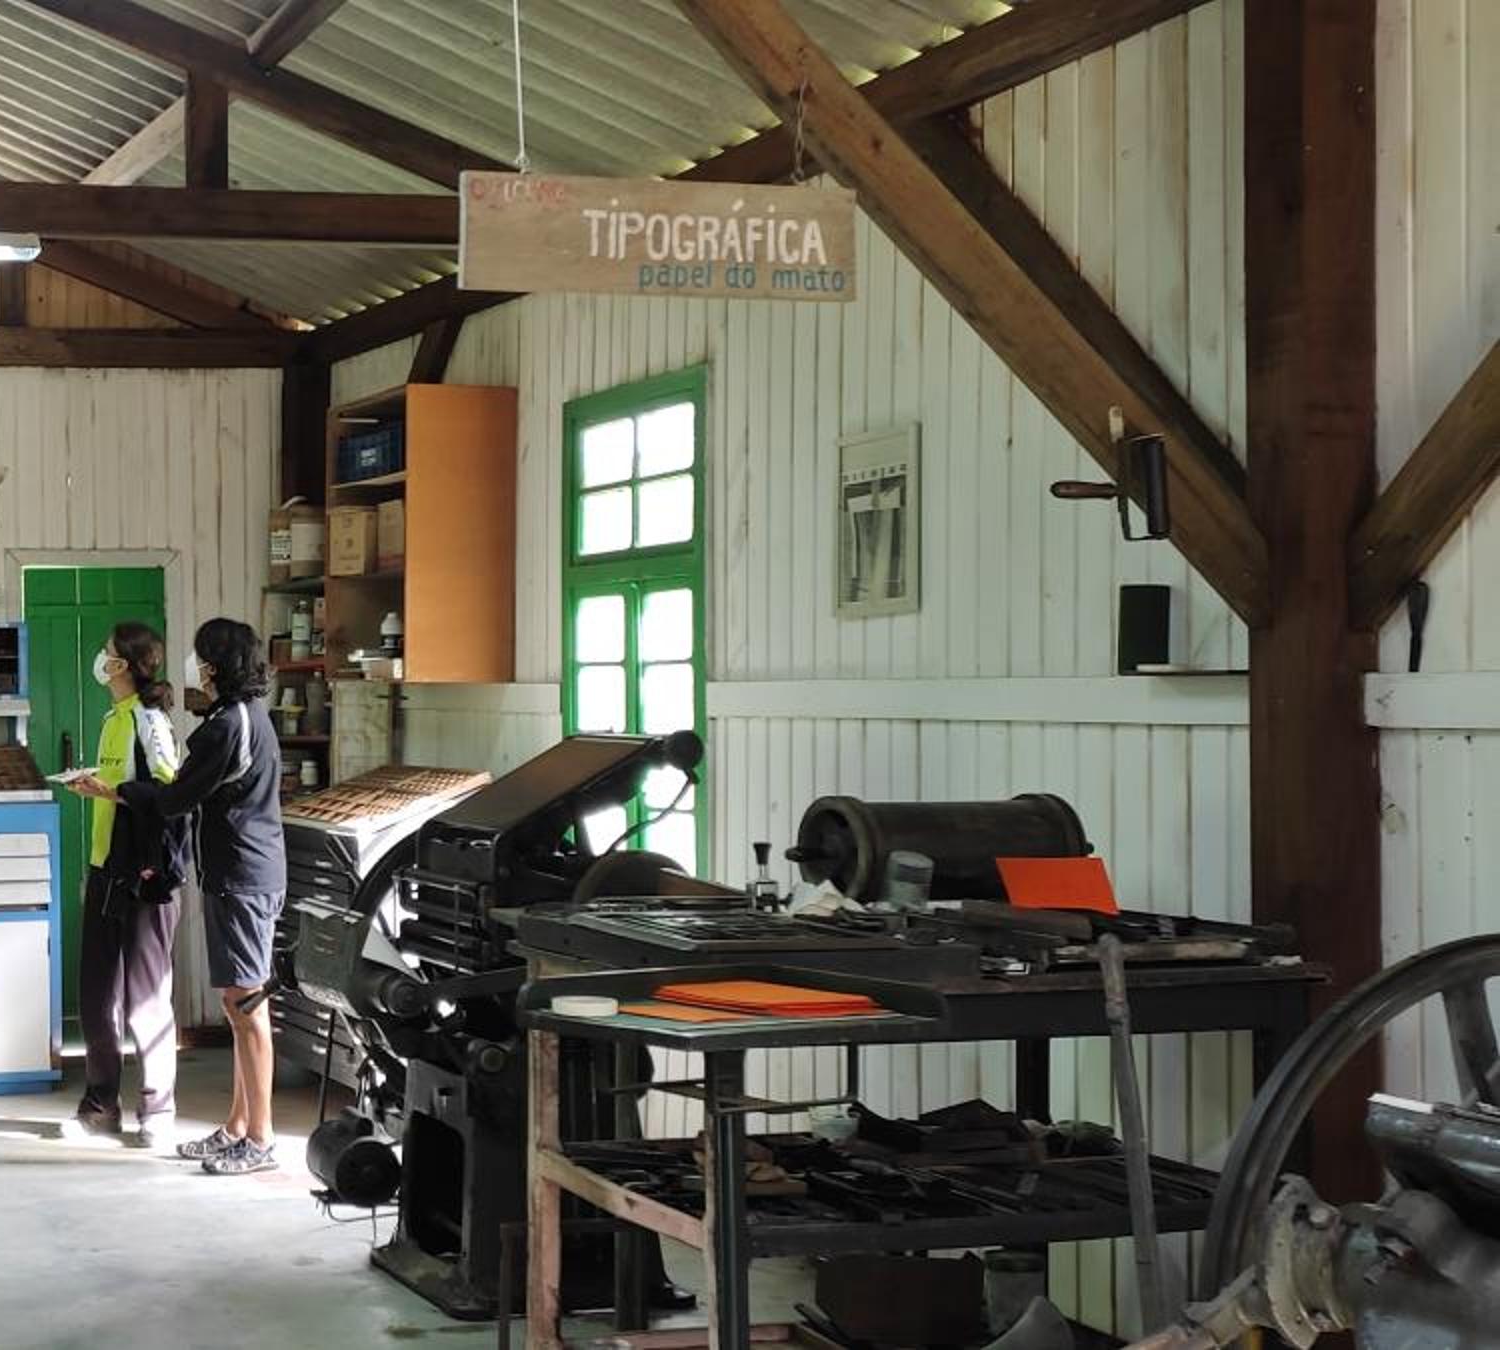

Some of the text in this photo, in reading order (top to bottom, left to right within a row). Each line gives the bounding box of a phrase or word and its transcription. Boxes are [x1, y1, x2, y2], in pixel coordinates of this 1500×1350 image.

[638, 261, 846, 292] papel do mato
